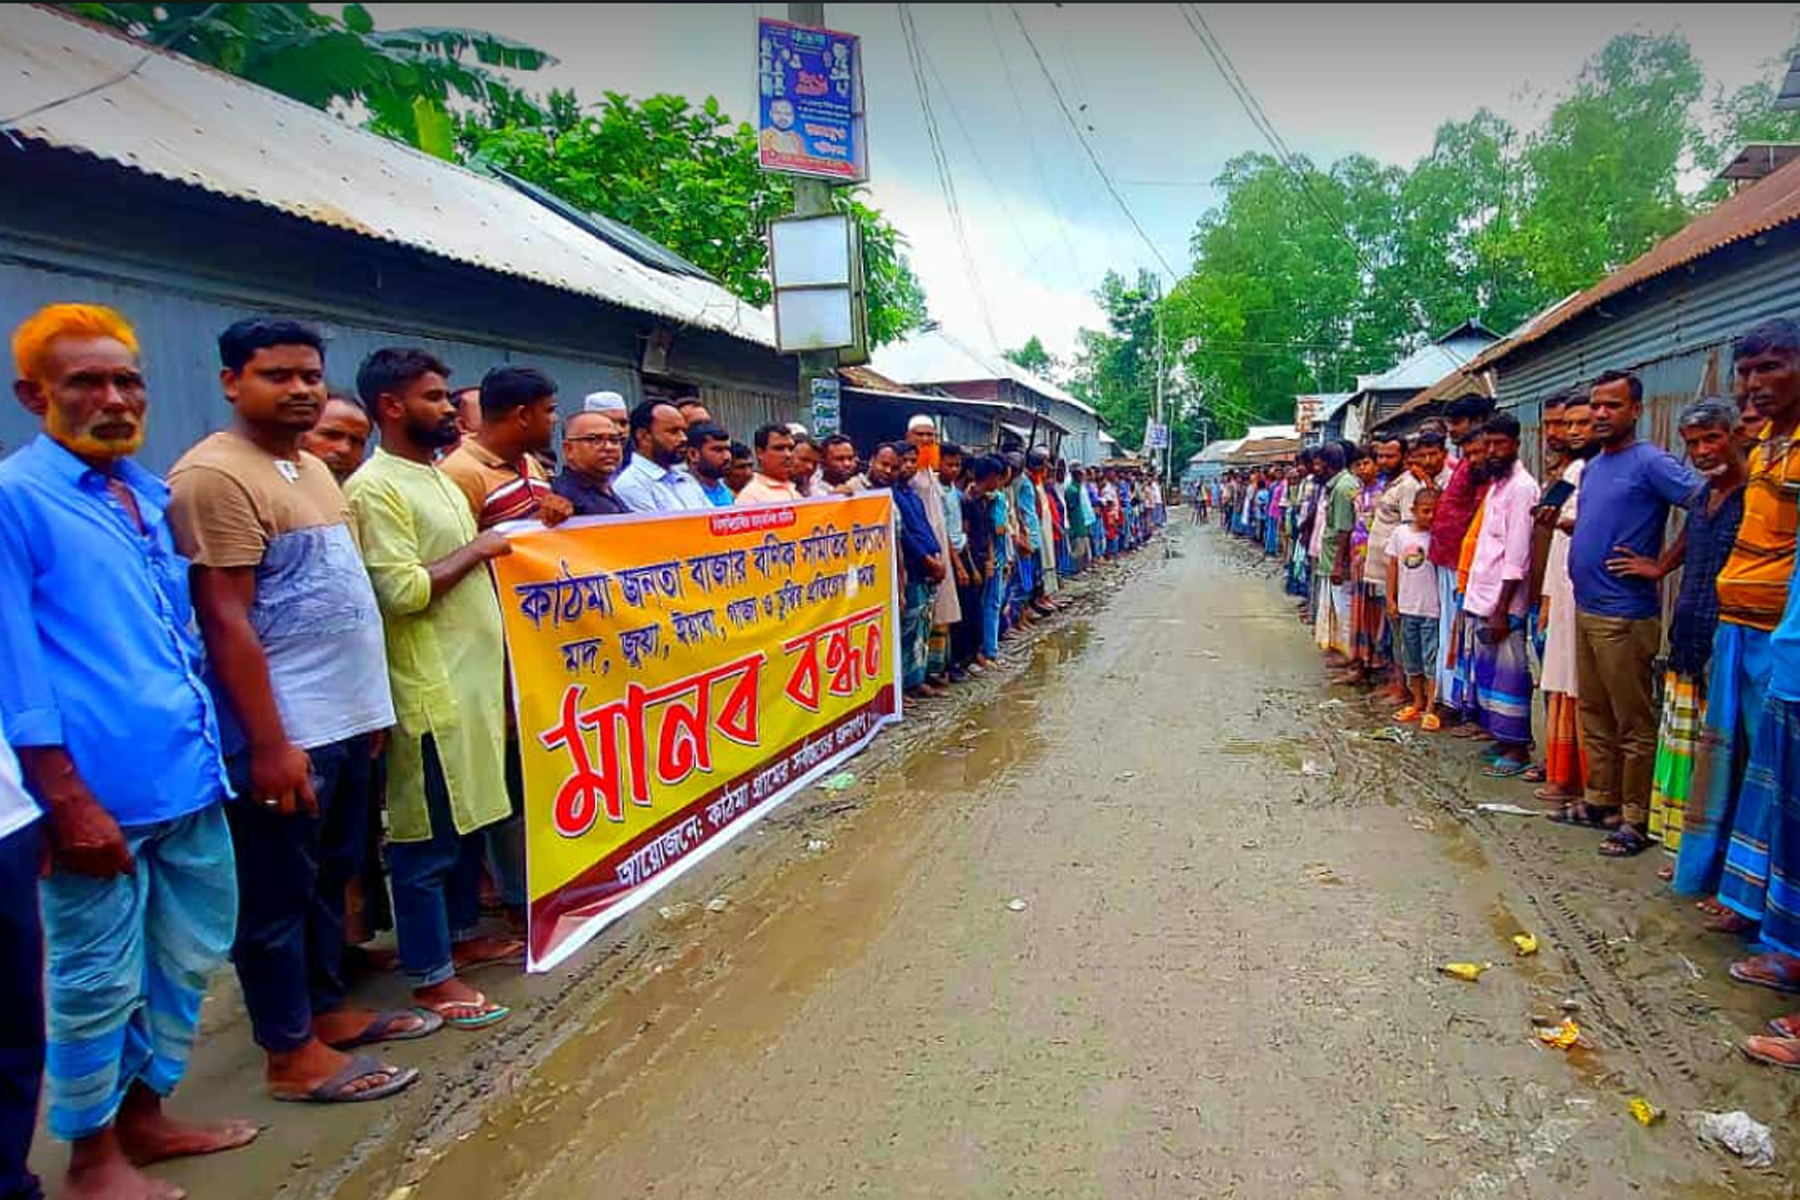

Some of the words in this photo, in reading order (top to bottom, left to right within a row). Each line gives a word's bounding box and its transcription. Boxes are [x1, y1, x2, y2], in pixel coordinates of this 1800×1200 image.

[615, 560, 684, 607] জনতা
[687, 549, 746, 593] বাজার
[751, 533, 798, 578] বণিক
[800, 523, 848, 565] সমিতির
[763, 594, 774, 616] ও
[541, 649, 767, 838] মানব
[782, 605, 885, 712] বন্ধন
